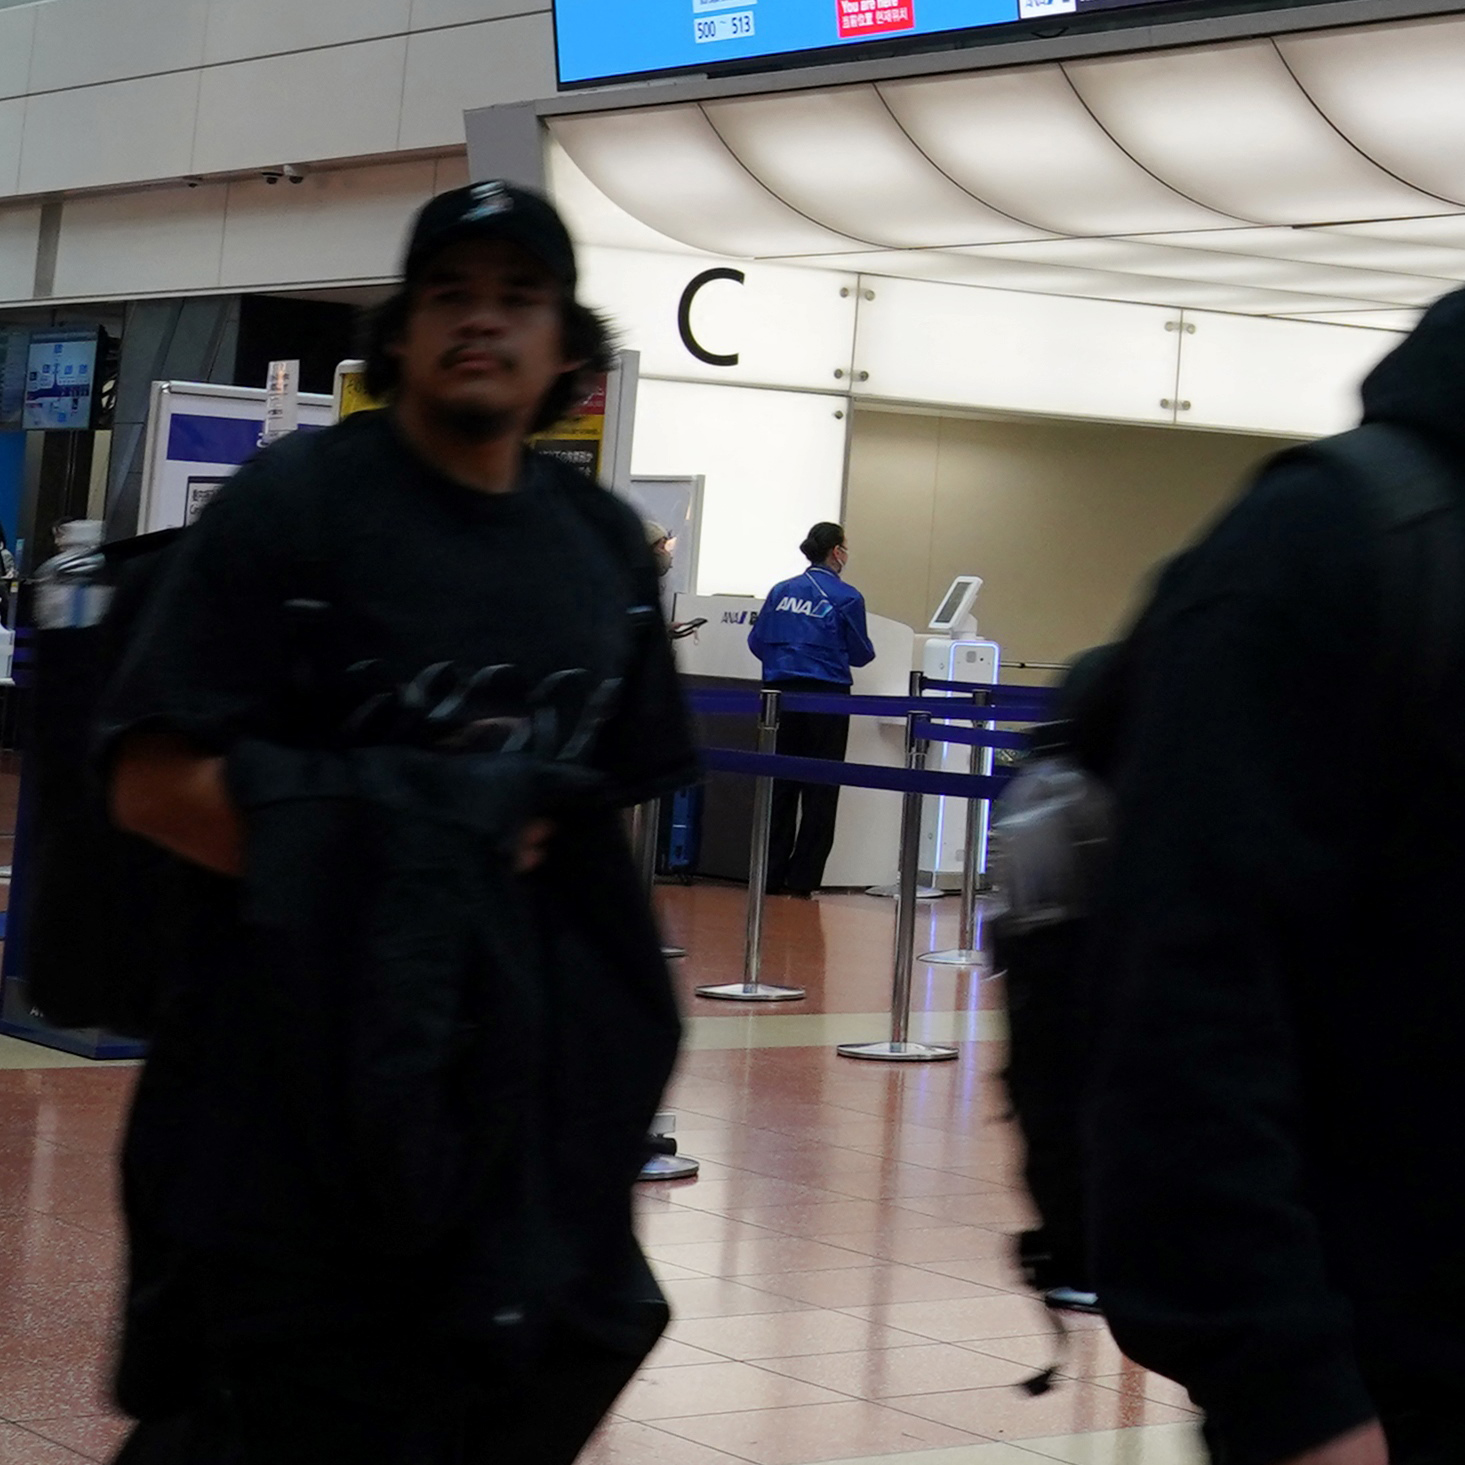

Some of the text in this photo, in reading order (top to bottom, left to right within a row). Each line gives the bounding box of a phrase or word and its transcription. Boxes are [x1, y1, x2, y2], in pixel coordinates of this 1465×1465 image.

[841, 0, 859, 14] You
[697, 15, 750, 39] 500 513
[677, 267, 745, 366] C
[776, 597, 812, 615] ANA
